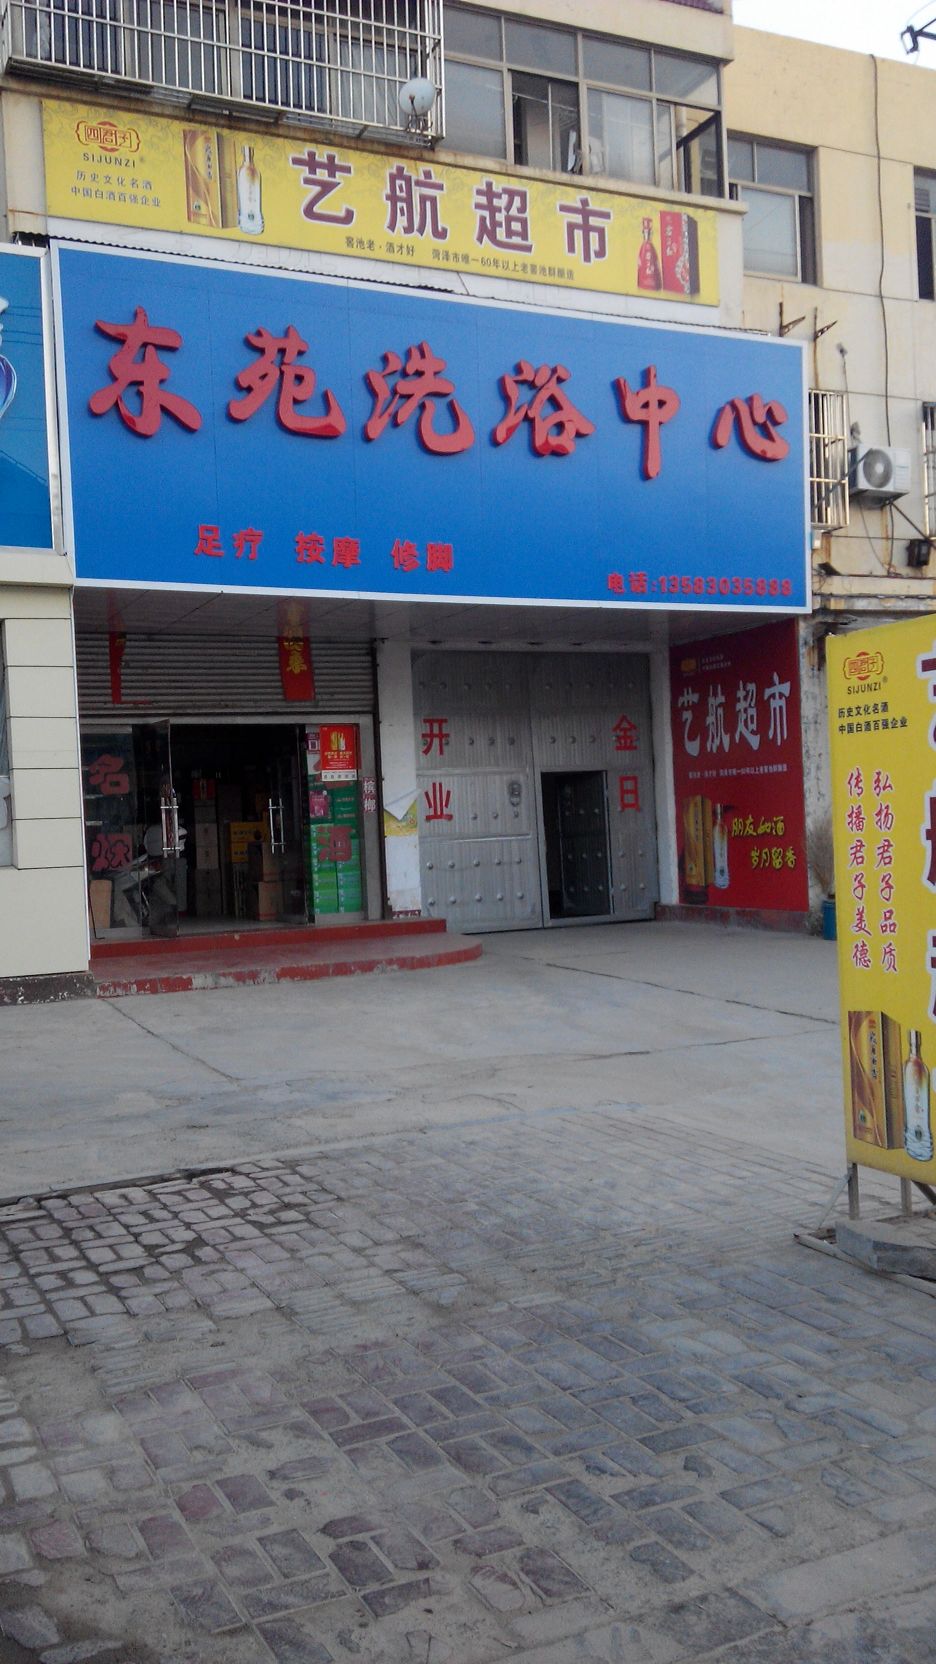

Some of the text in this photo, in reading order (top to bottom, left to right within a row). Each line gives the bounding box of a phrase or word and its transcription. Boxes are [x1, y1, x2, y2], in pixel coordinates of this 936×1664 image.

[83, 152, 136, 168] SIJUNZI
[71, 185, 161, 207] 中国白酒百强企业
[76, 170, 153, 191] 历史文化名酒
[291, 150, 612, 263] 艺航超市
[89, 306, 790, 481] 东苑洗浴中心
[194, 524, 454, 573] 足疗 按摩 修脚
[847, 683, 882, 695] SIJUNZI
[678, 671, 791, 758] 艺航超市
[838, 701, 889, 719] 历史文化名酒
[838, 716, 908, 735] 中国白酒百强企业
[847, 766, 872, 971] 传播君子美德
[872, 768, 898, 974] 弘扬君子品质
